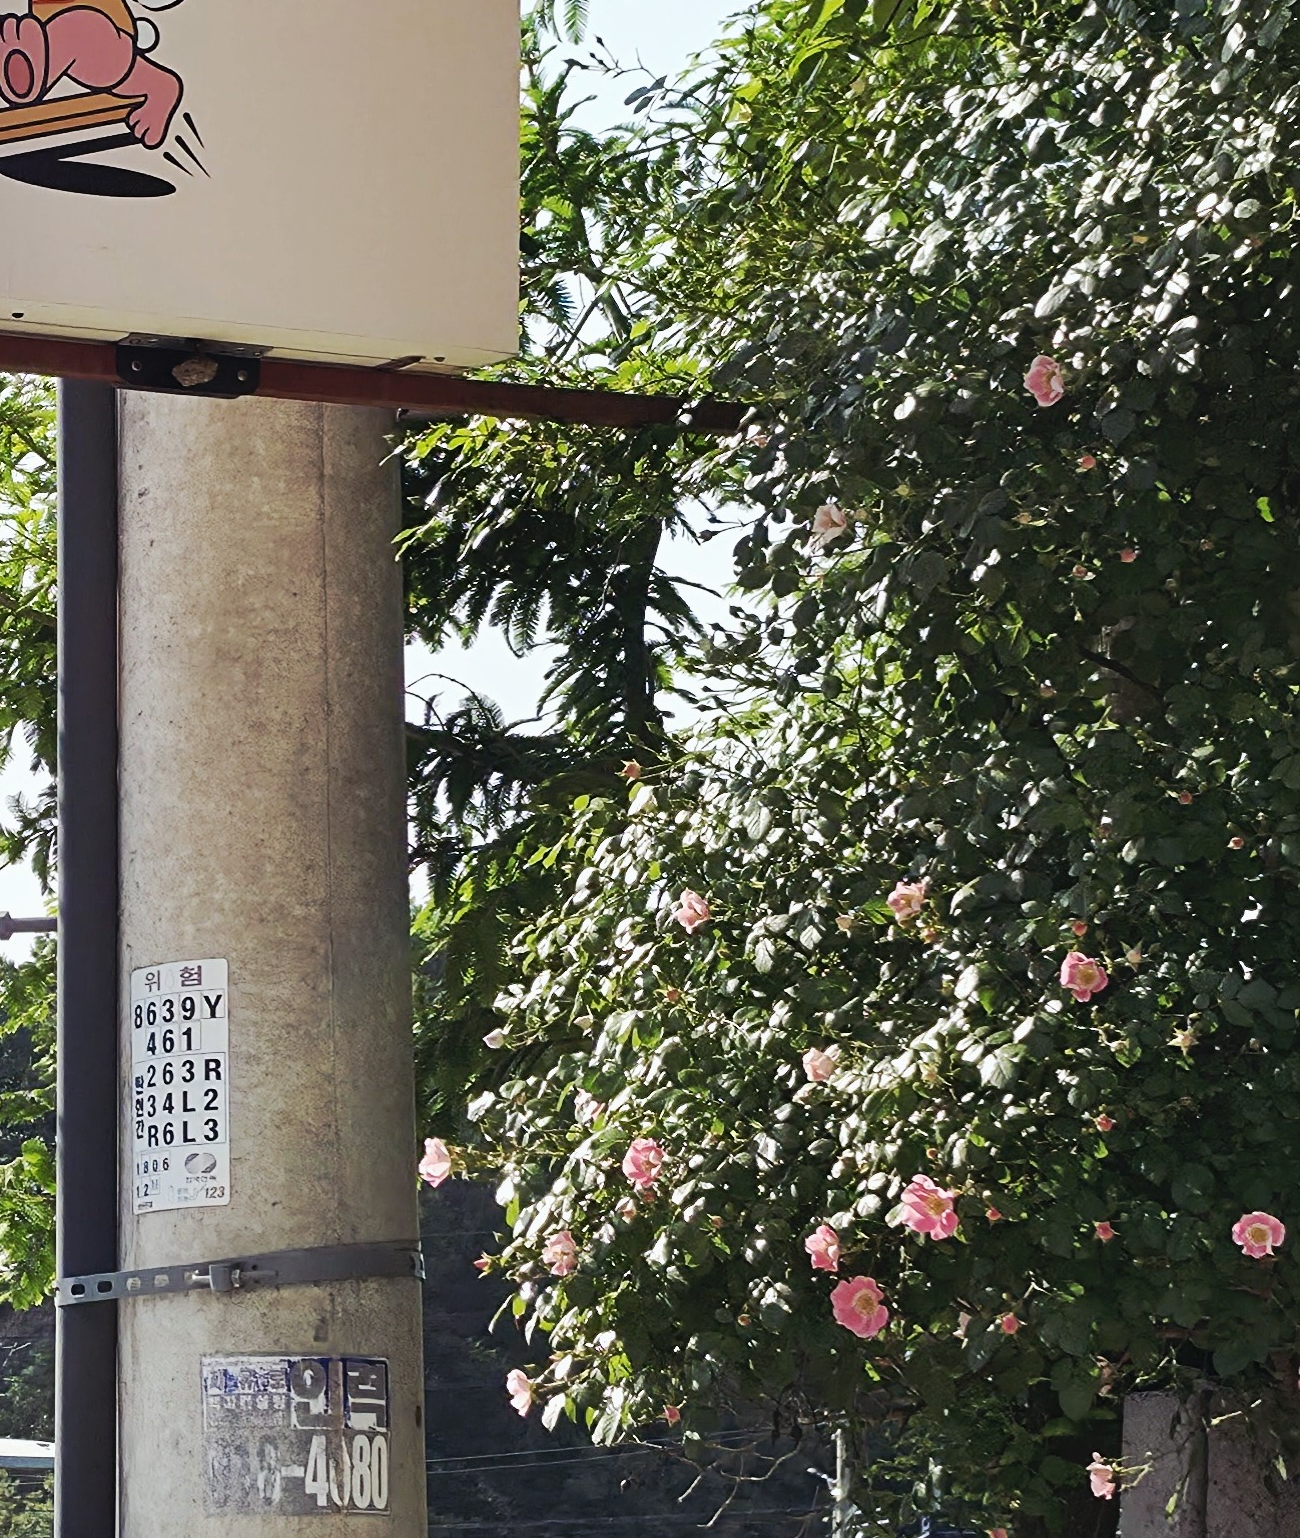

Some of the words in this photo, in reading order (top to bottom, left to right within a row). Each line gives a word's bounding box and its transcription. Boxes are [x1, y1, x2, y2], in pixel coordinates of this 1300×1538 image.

[134, 994, 223, 1029] 8639Y
[146, 1027, 193, 1056] 461
[147, 1058, 222, 1087] 263R
[147, 1088, 219, 1117] 34L2
[147, 1118, 219, 1148] R6L3
[205, 1186, 225, 1199] 123
